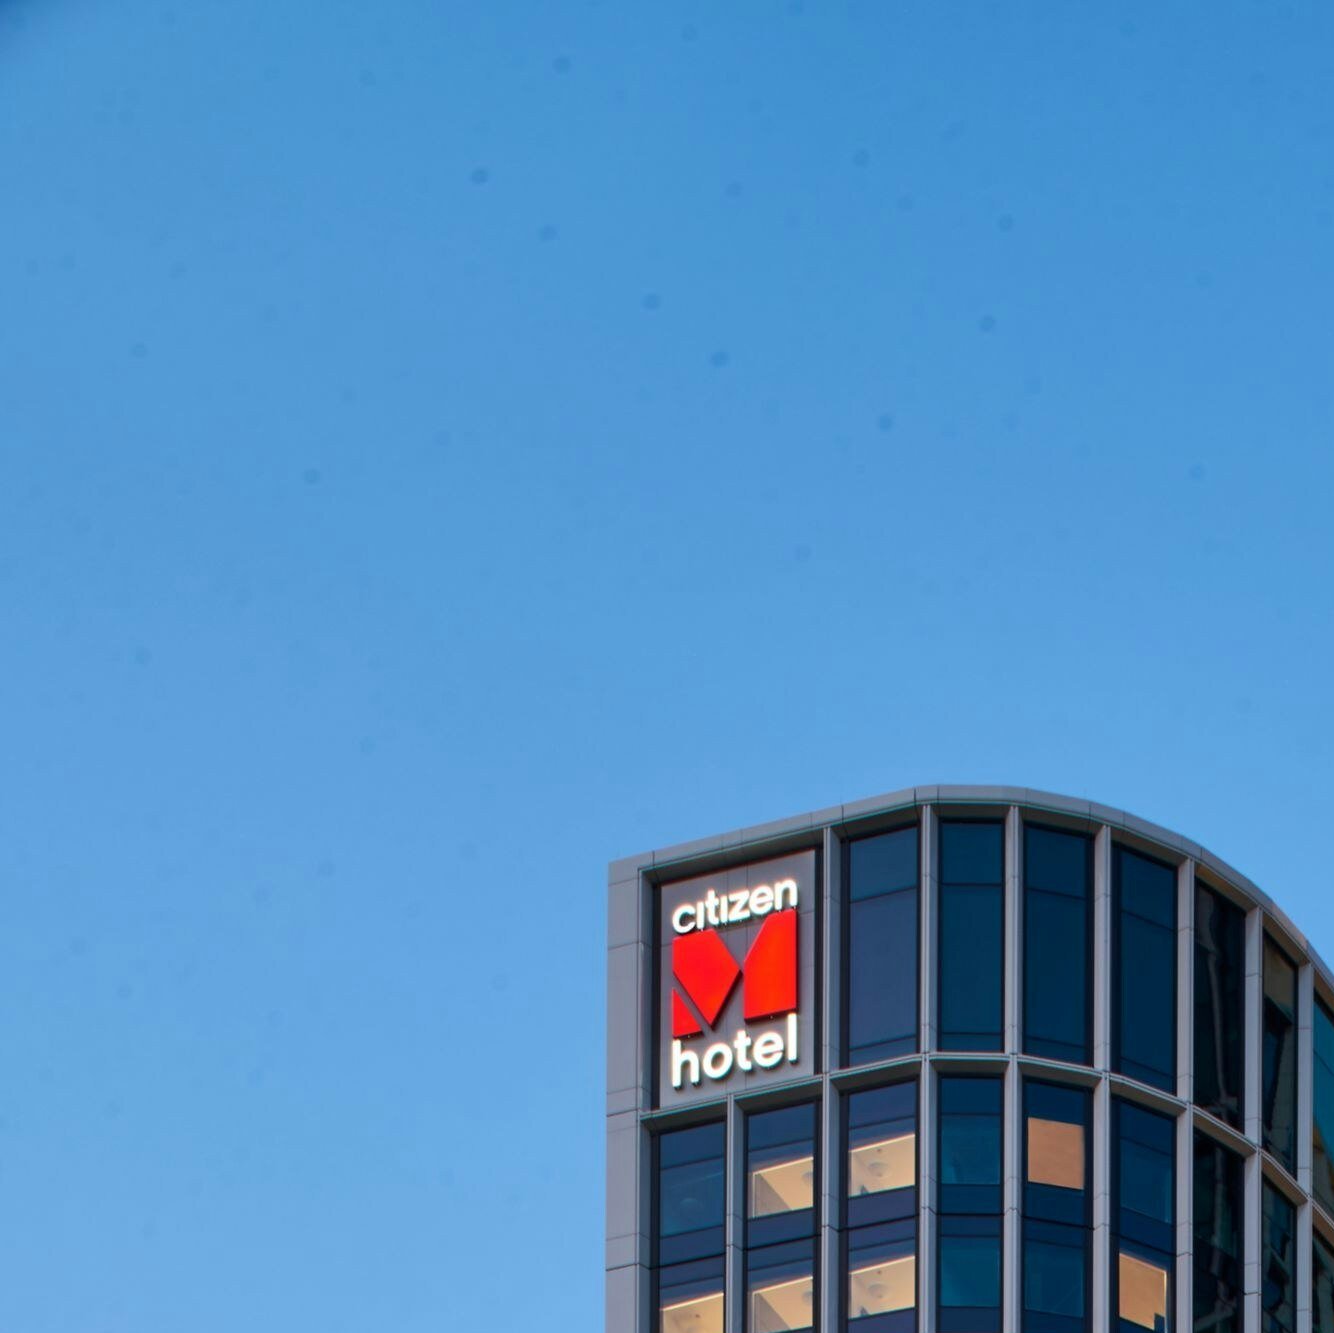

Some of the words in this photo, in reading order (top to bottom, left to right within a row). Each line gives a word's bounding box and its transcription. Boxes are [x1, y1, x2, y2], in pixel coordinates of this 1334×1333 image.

[671, 878, 798, 934] citizen
[671, 907, 797, 1038] M
[671, 1012, 798, 1089] hotel
